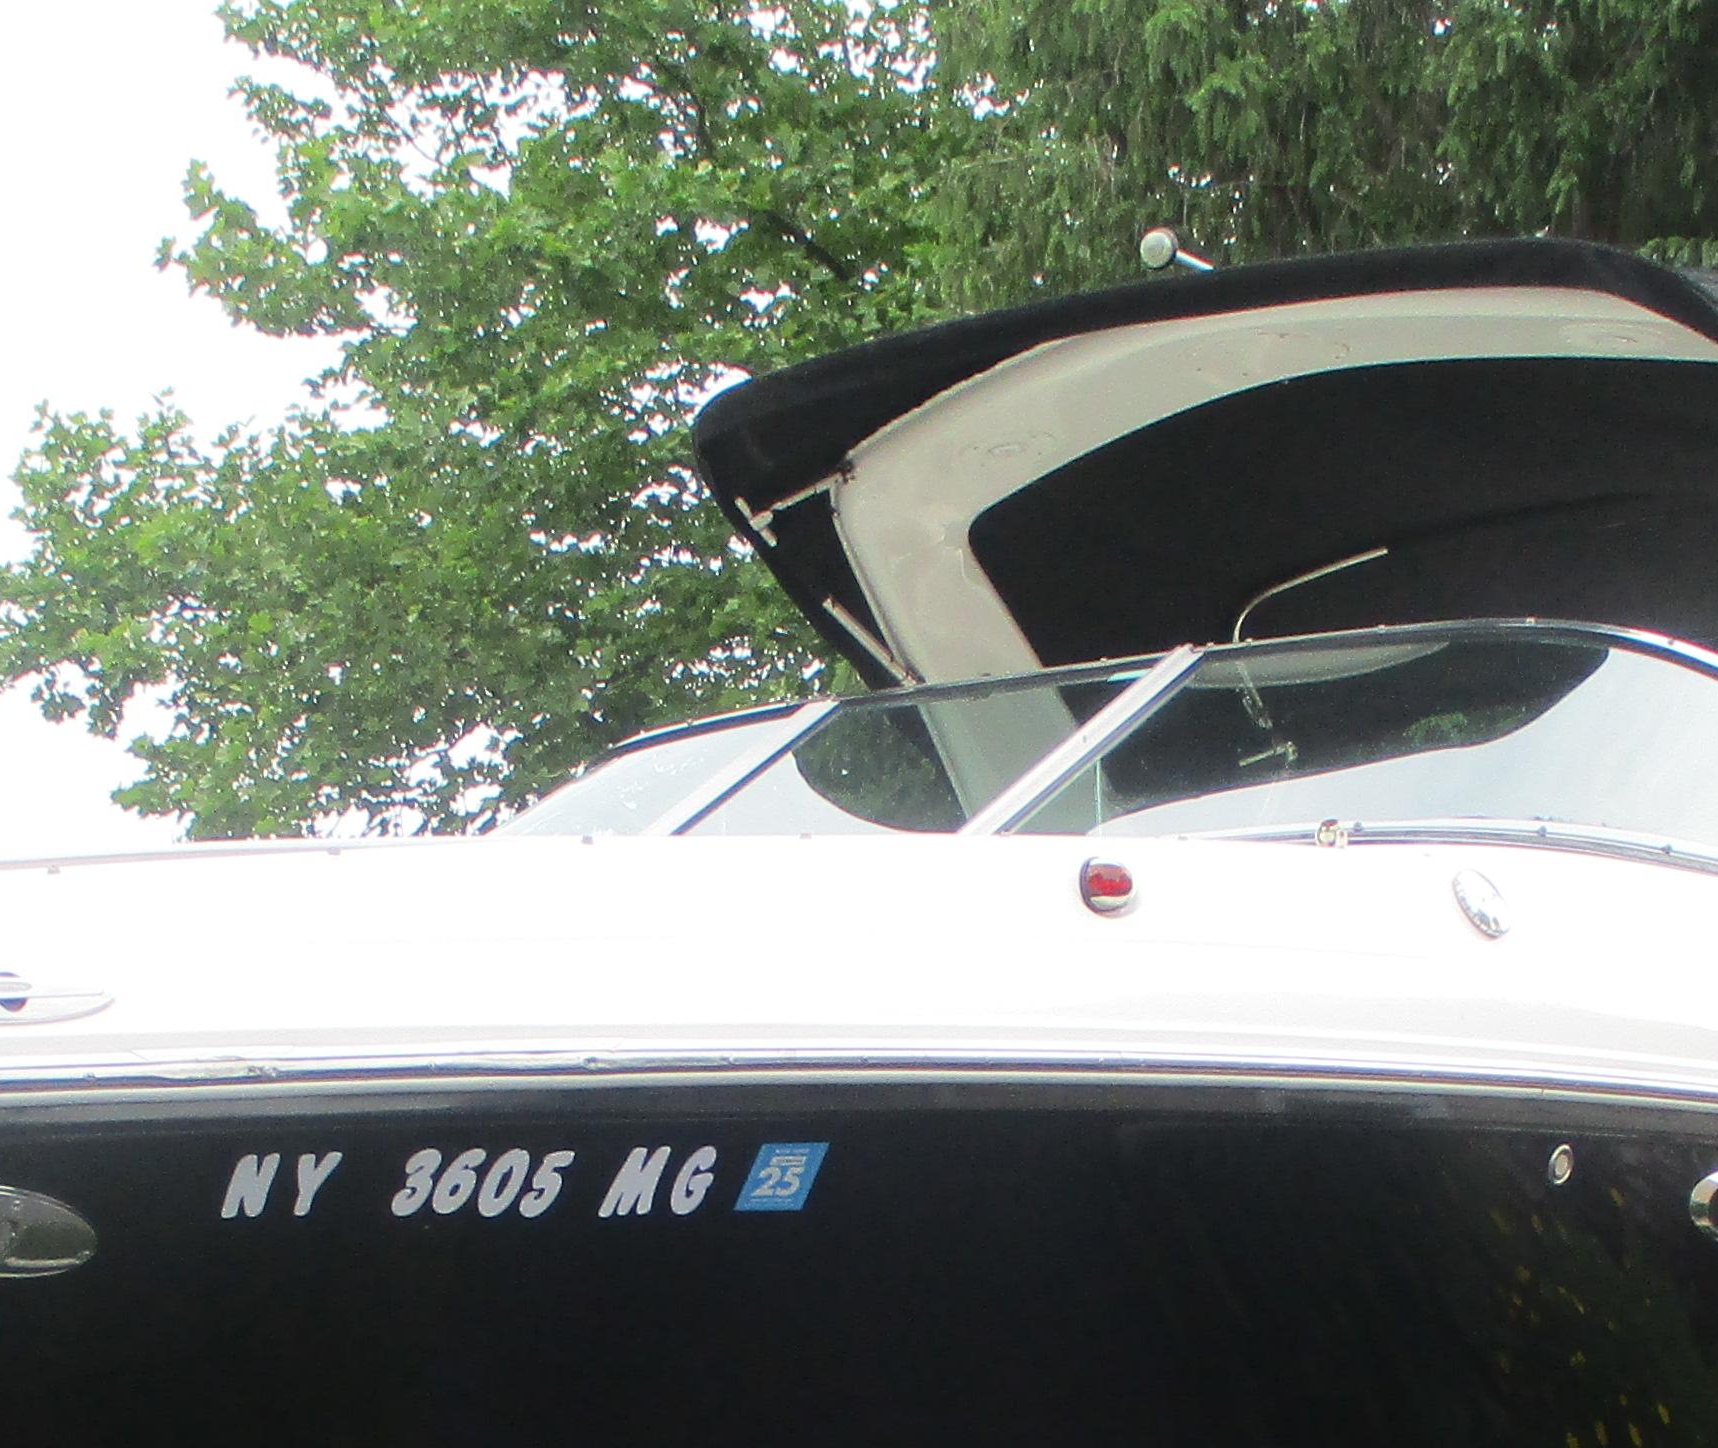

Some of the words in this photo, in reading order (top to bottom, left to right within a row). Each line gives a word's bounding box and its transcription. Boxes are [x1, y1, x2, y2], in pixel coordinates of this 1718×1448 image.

[220, 1151, 343, 1218] NY
[391, 1147, 575, 1218] 3605
[598, 1146, 717, 1217] MG
[750, 1166, 804, 1198] 25
